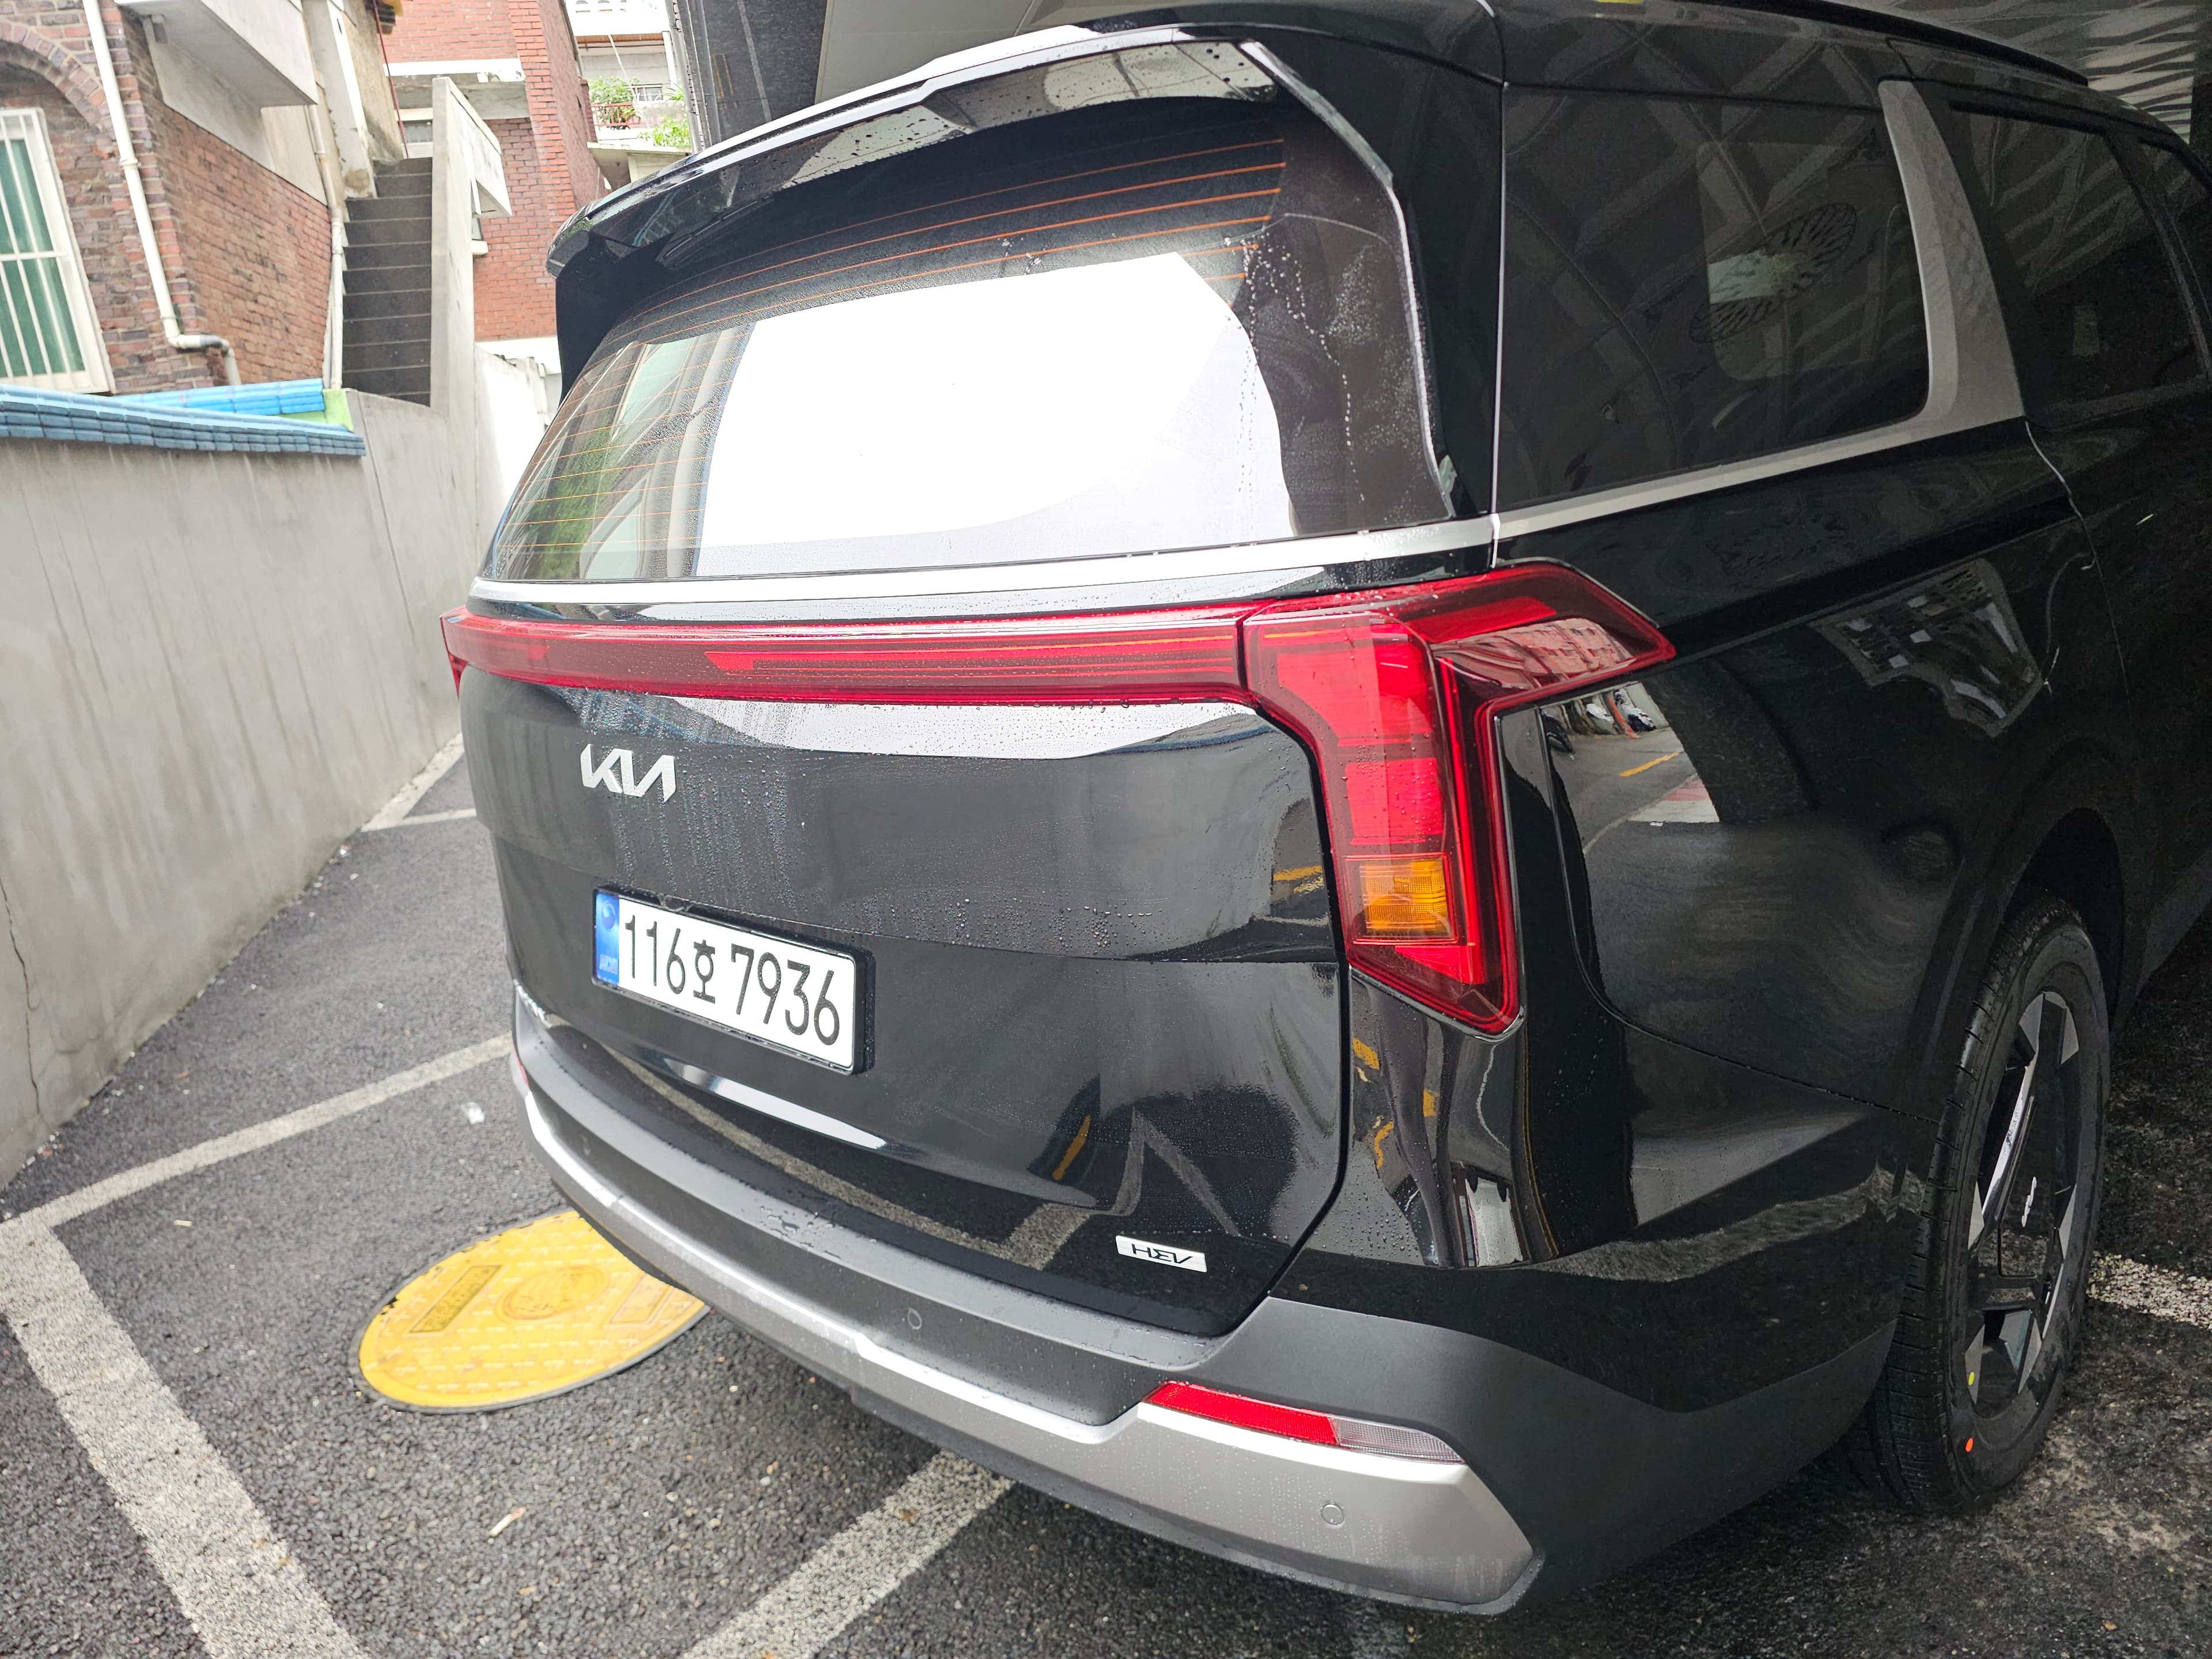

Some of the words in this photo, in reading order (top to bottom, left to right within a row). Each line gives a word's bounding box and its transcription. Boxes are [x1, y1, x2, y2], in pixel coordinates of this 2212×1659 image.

[581, 744, 676, 803] KIA
[625, 915, 715, 1004] 116호
[730, 943, 840, 1046] 7936
[1131, 1244, 1194, 1264] HEV
